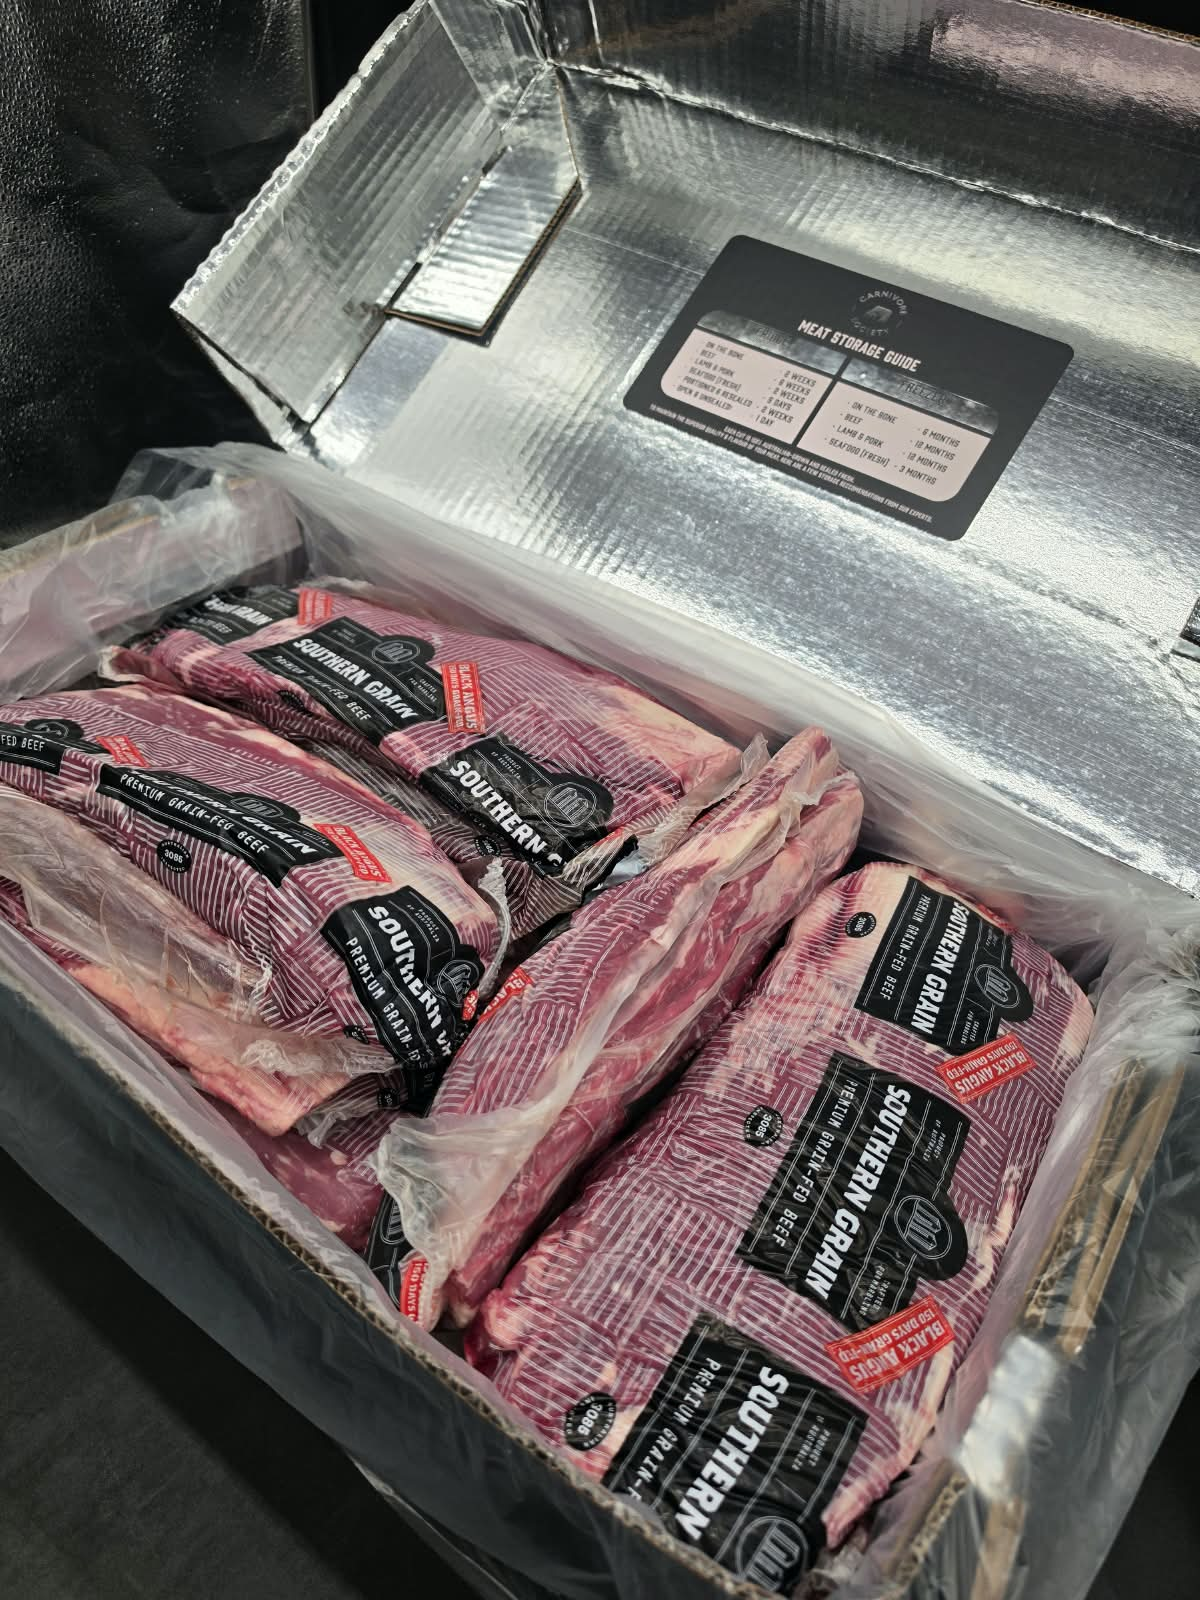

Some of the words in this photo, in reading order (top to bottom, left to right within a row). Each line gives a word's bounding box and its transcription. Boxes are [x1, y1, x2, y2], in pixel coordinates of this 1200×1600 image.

[797, 320, 832, 340] MEAT
[830, 332, 885, 359] STORAGE
[884, 350, 921, 372] GUIDE
[694, 358, 712, 369] LAMB
[676, 385, 692, 395] OPEN
[785, 380, 810, 396] WEEKS
[791, 372, 816, 387] WEEKS
[721, 390, 753, 407] RESEALED
[773, 398, 792, 411] DAYS
[780, 389, 806, 405] WEEKS
[760, 416, 775, 426] DAY
[768, 408, 794, 423] WEEKS
[844, 413, 863, 425] BEEF
[851, 401, 862, 411] ON
[864, 406, 876, 416] THE
[878, 411, 898, 424] BONE
[829, 437, 861, 456] SEAFOOD
[837, 425, 858, 438] LAMB
[864, 435, 885, 448] PORK
[929, 430, 960, 448] MONTHS
[916, 455, 948, 473] MONTHS
[924, 443, 956, 461] MONTHS
[905, 468, 937, 486] MONTHS
[884, 498, 899, 509] FROM
[293, 638, 371, 686] SOUTHERN
[363, 680, 418, 719] GRAIN
[459, 664, 474, 690] BLACK
[347, 701, 372, 721] BEEF
[452, 690, 464, 728] GRAIN-FED
[462, 691, 478, 729] ANGUS
[21, 737, 45, 752] BEEF
[120, 774, 165, 802] PREMIUM
[168, 797, 235, 831] GRAIN-FED
[237, 830, 270, 854] BEEF
[449, 760, 548, 854] SOUTHERN
[335, 827, 361, 849] BLACK
[164, 849, 184, 863] 3085
[418, 909, 439, 931] PRODUCT
[912, 894, 931, 923] PREMIUM
[414, 912, 440, 942] AUSTRALIA
[930, 901, 970, 975] SOUTHERN
[891, 924, 919, 972] GRAIN-FED
[346, 937, 386, 1000] PREMIUM
[879, 975, 897, 1001] BEEF
[910, 973, 948, 1035] GRAIN
[986, 1046, 1007, 1061] DAYS
[992, 1051, 1027, 1076] BLACK
[946, 1056, 988, 1080] GRAIN-FED
[954, 1065, 994, 1094] ANGUS
[827, 1079, 858, 1129] PREMIUM
[755, 1113, 772, 1138] 3085
[843, 1084, 912, 1212] SOUTHERN
[922, 1128, 938, 1161] AUSTRALIA
[933, 1132, 946, 1159] PRODUCT
[792, 1131, 835, 1204] GRAIN-FED
[772, 1208, 798, 1247] BEEF
[805, 1207, 860, 1300] GRAIN
[874, 1265, 885, 1280] FOR
[407, 1284, 417, 1312] DAYS
[859, 1279, 879, 1316] MARBLING
[872, 1280, 891, 1310] CRAFTED
[891, 1318, 919, 1340] DAYS
[918, 1308, 935, 1325] 150
[897, 1320, 945, 1359] BLACK
[848, 1347, 900, 1381] ANGUS
[673, 1357, 722, 1426] PREMIUM
[577, 1402, 603, 1436] 3085
[675, 1366, 790, 1541] SOUTHERN
[791, 1424, 820, 1471] AUSTRALIA
[808, 1428, 831, 1467] PRODUCT
